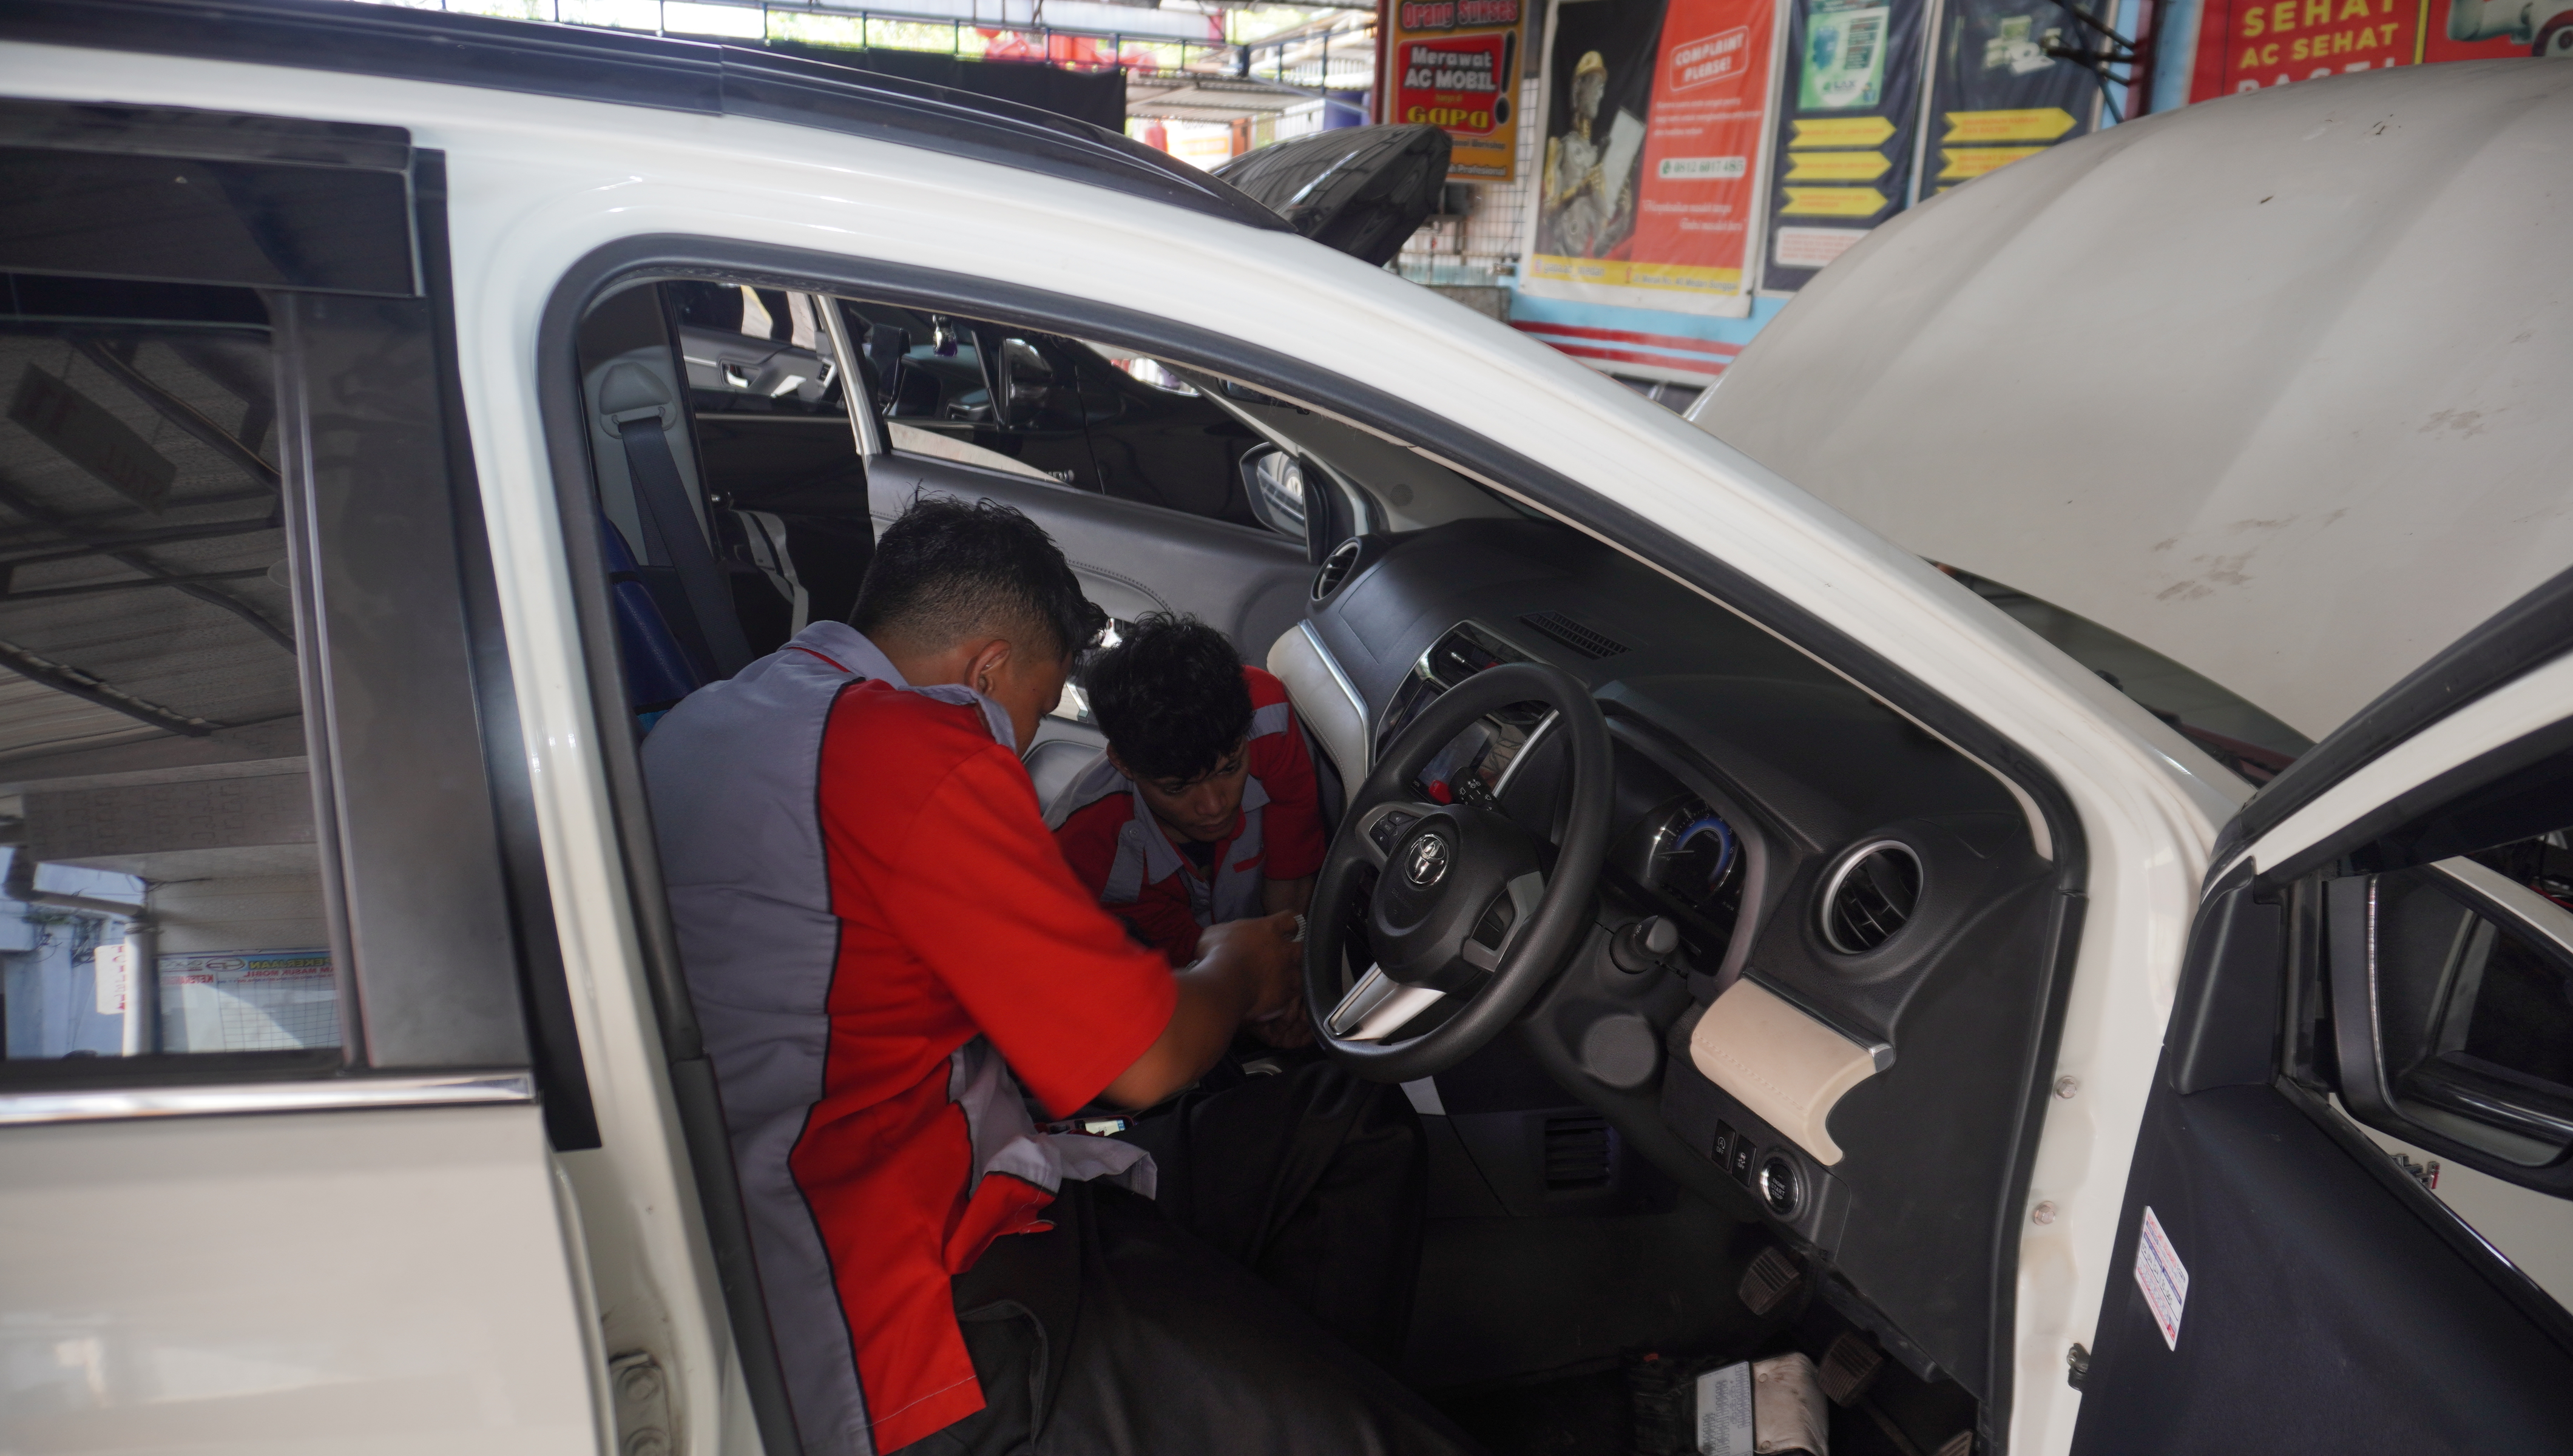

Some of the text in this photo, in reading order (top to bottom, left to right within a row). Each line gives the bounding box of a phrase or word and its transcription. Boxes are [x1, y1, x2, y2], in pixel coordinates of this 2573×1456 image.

[1675, 33, 1744, 67] COMPLAINT
[2240, 22, 2398, 69] AC SEHAT
[1411, 46, 1492, 67] Merawat
[1403, 68, 1496, 90] AC MOBIL
[1684, 56, 1732, 82] PLEASE!
[1771, 1184, 1785, 1196] START
[1772, 1190, 1784, 1199] STOP
[1773, 1178, 1785, 1190] ENGINE
